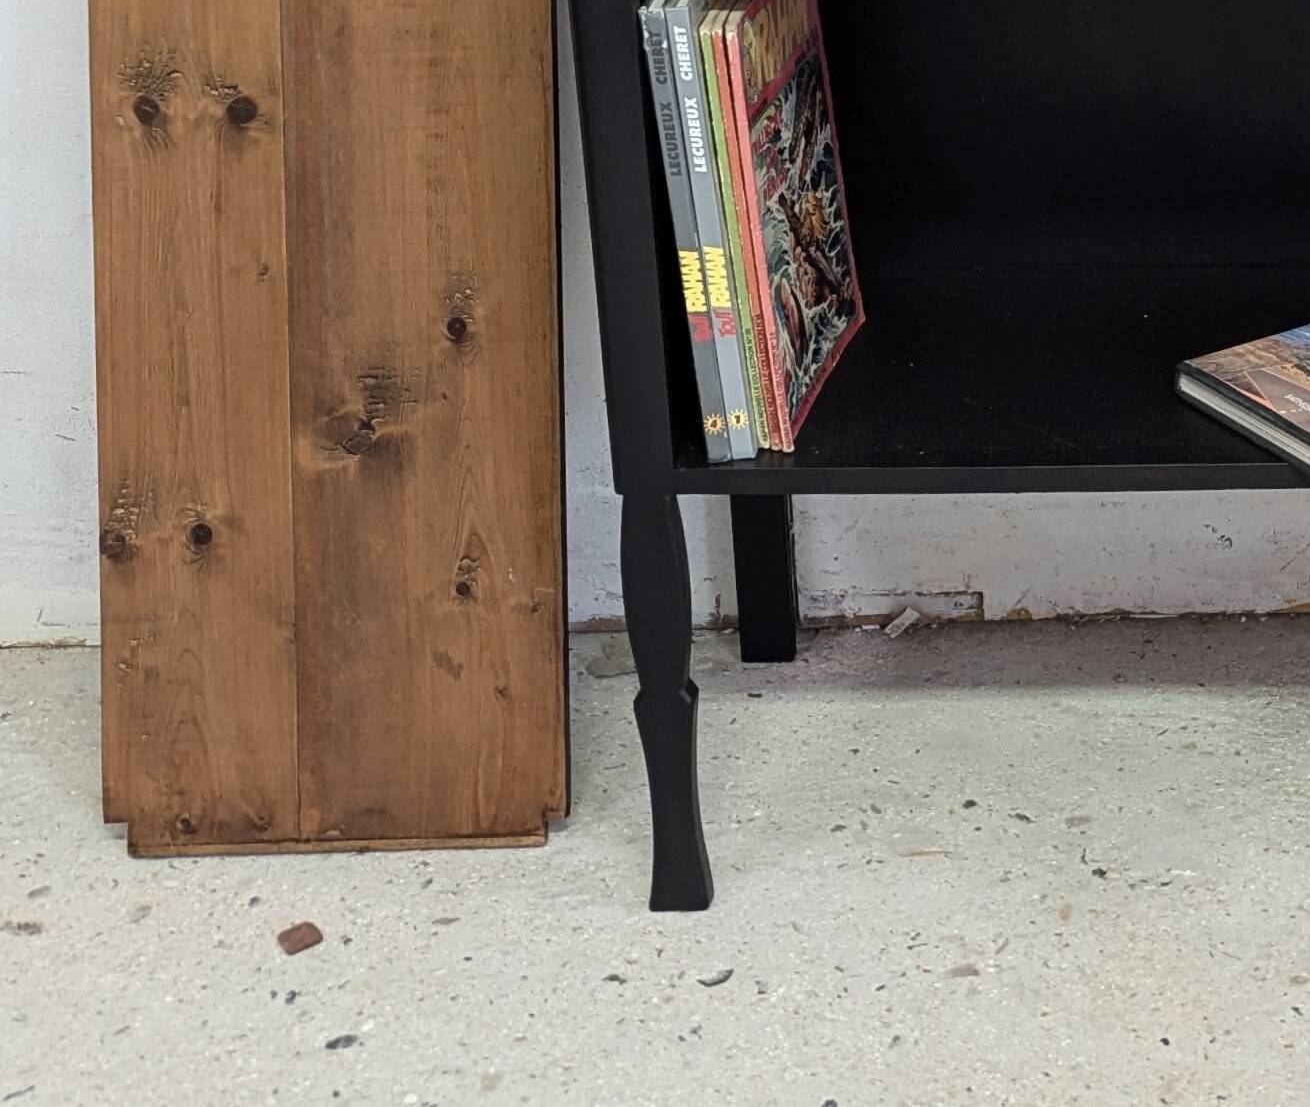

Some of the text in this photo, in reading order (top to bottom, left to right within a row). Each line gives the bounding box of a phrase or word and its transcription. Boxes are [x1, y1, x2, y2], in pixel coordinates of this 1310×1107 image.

[648, 30, 683, 177] LECUREUX CHERET
[673, 25, 708, 173] LECUREUX CHERET
[679, 250, 708, 313] RAHAN
[703, 246, 733, 308] RAHAN
[710, 419, 718, 429] 4
